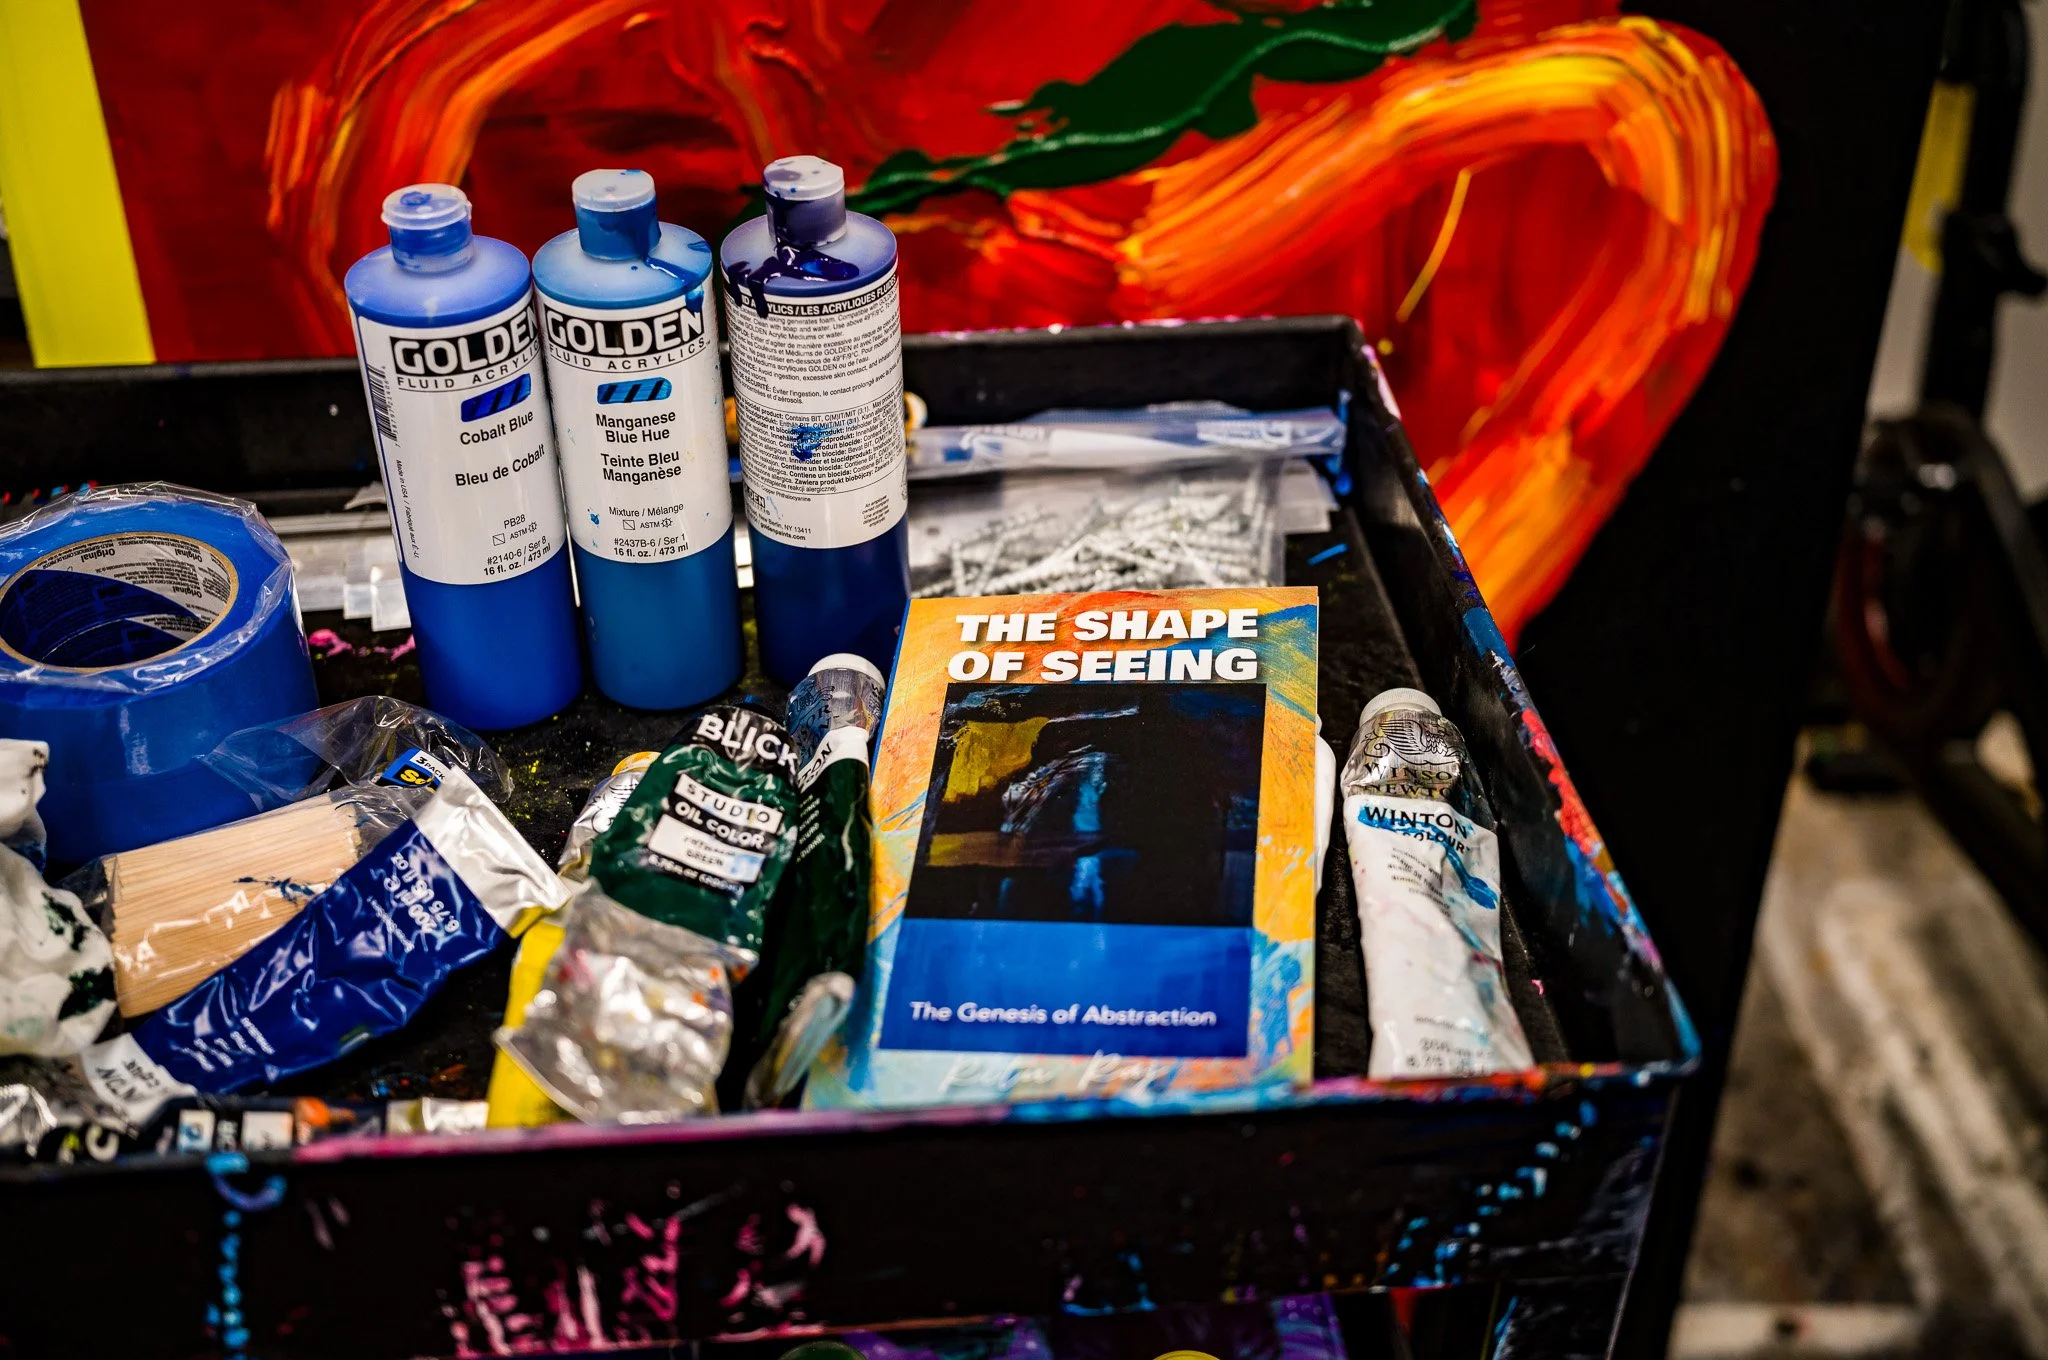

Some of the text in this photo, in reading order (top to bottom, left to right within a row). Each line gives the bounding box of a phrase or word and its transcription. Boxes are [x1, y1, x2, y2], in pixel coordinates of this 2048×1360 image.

[801, 306, 820, 315] LES
[822, 292, 876, 314] ACRYLIQUES
[547, 308, 703, 356] GOLDEN
[394, 306, 538, 375] GOLDEN
[824, 339, 852, 348] excessive
[550, 344, 591, 367] FLUID
[824, 345, 852, 356] GOLDEN
[397, 377, 454, 389] FLUID
[774, 372, 801, 381] ingestion,
[830, 386, 851, 395] contact
[761, 408, 783, 419] product:
[460, 410, 534, 445] Cobalt Blue
[596, 412, 676, 431] Manganese
[606, 429, 670, 444] Blue Hue
[818, 428, 845, 437] produkt:
[839, 439, 862, 447] biocide:
[601, 451, 680, 467] Teinte Bleu
[831, 448, 872, 463] biocidprodukt:
[455, 444, 545, 486] Bleu de Cobalt
[781, 462, 807, 471] Contiene
[603, 466, 681, 485] Manganèse
[828, 469, 852, 478] biocida:
[820, 478, 844, 486] produkt
[609, 506, 640, 517] Mixture
[648, 504, 684, 517] Mélange
[504, 514, 526, 529] PB28
[510, 528, 527, 540] ASTM
[760, 523, 806, 540] goldenpaints.com
[614, 538, 656, 548] #2437B-6
[664, 536, 679, 546] Ser
[614, 547, 624, 556] 16
[626, 549, 635, 557] fl.
[638, 549, 652, 557] oz.
[659, 546, 676, 556] 473
[678, 542, 688, 552] ml
[81, 549, 115, 562] Original
[175, 549, 202, 562] Original
[487, 550, 522, 566] #2140-6
[528, 541, 540, 553] Ser
[542, 536, 547, 545] 8
[484, 567, 495, 576] 16
[497, 564, 506, 573] fl.
[509, 562, 521, 570] oz.
[528, 550, 542, 562] 473
[543, 543, 551, 554] ml
[172, 586, 202, 598] Original
[956, 608, 1258, 642] THE SHAPE
[948, 648, 1258, 681] OF SEEING
[697, 714, 798, 775] BLICK
[687, 783, 770, 823] STUDIO
[675, 801, 703, 825] OIL
[706, 819, 765, 849] COLOR
[1364, 806, 1467, 839] WINTON
[408, 904, 437, 932] 200
[428, 901, 459, 933] 6.75
[911, 1002, 1217, 1026] The Genesis of Abstraction
